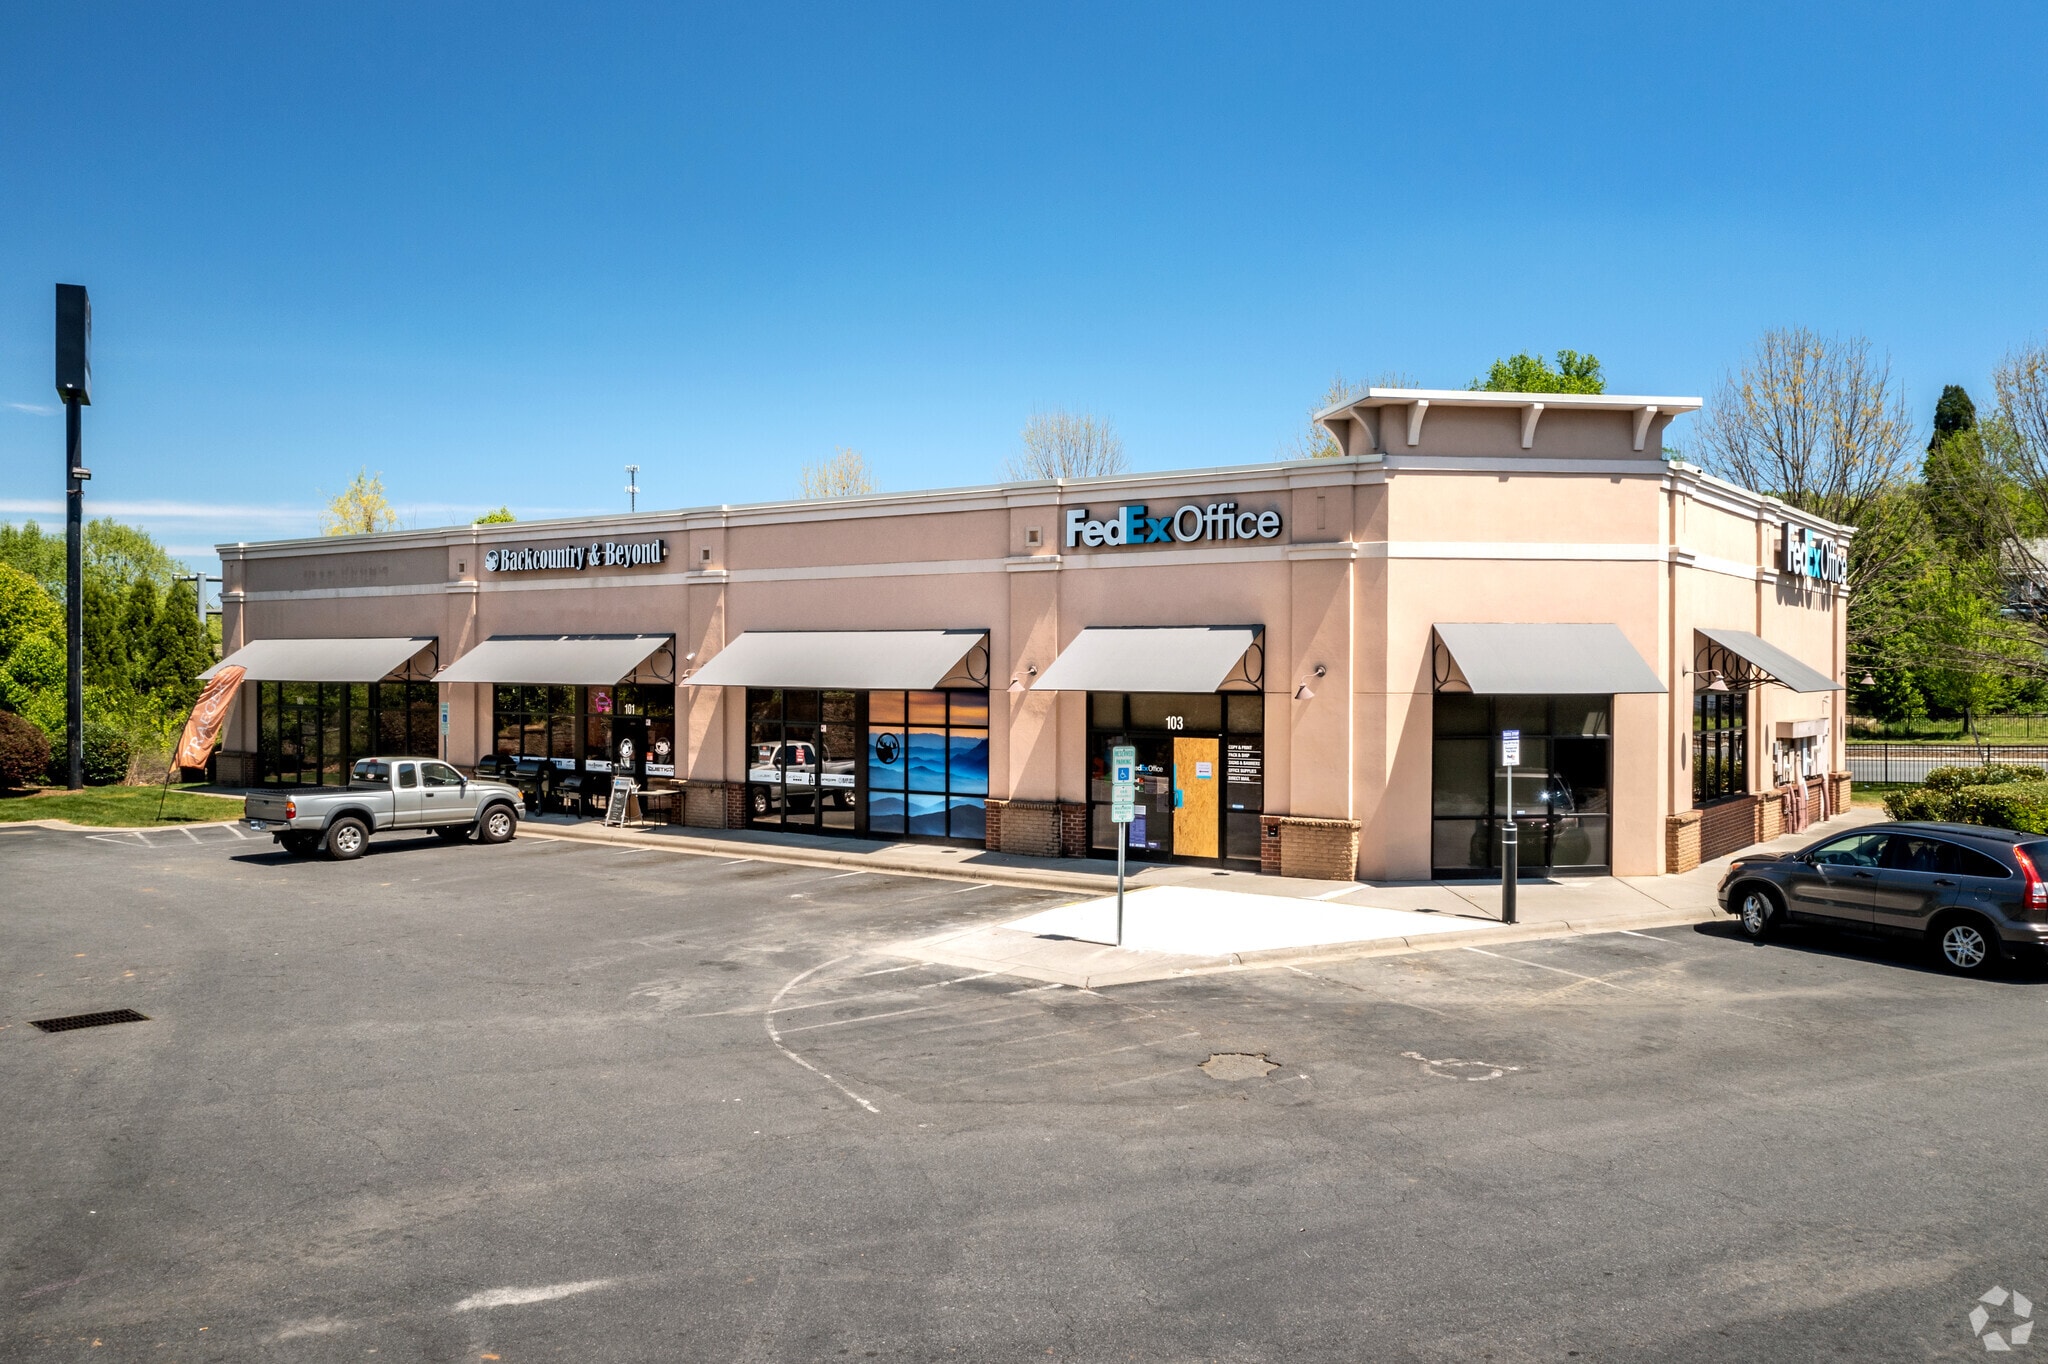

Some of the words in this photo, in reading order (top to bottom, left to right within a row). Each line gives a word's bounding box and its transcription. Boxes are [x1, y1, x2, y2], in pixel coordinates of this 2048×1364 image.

[1067, 505, 1173, 547] FedEx
[1173, 503, 1281, 542] Office
[500, 546, 586, 572] Backcountry
[589, 543, 600, 566] &
[604, 540, 662, 568] Beyond
[624, 703, 635, 715] 101
[1165, 715, 1184, 730] 103
